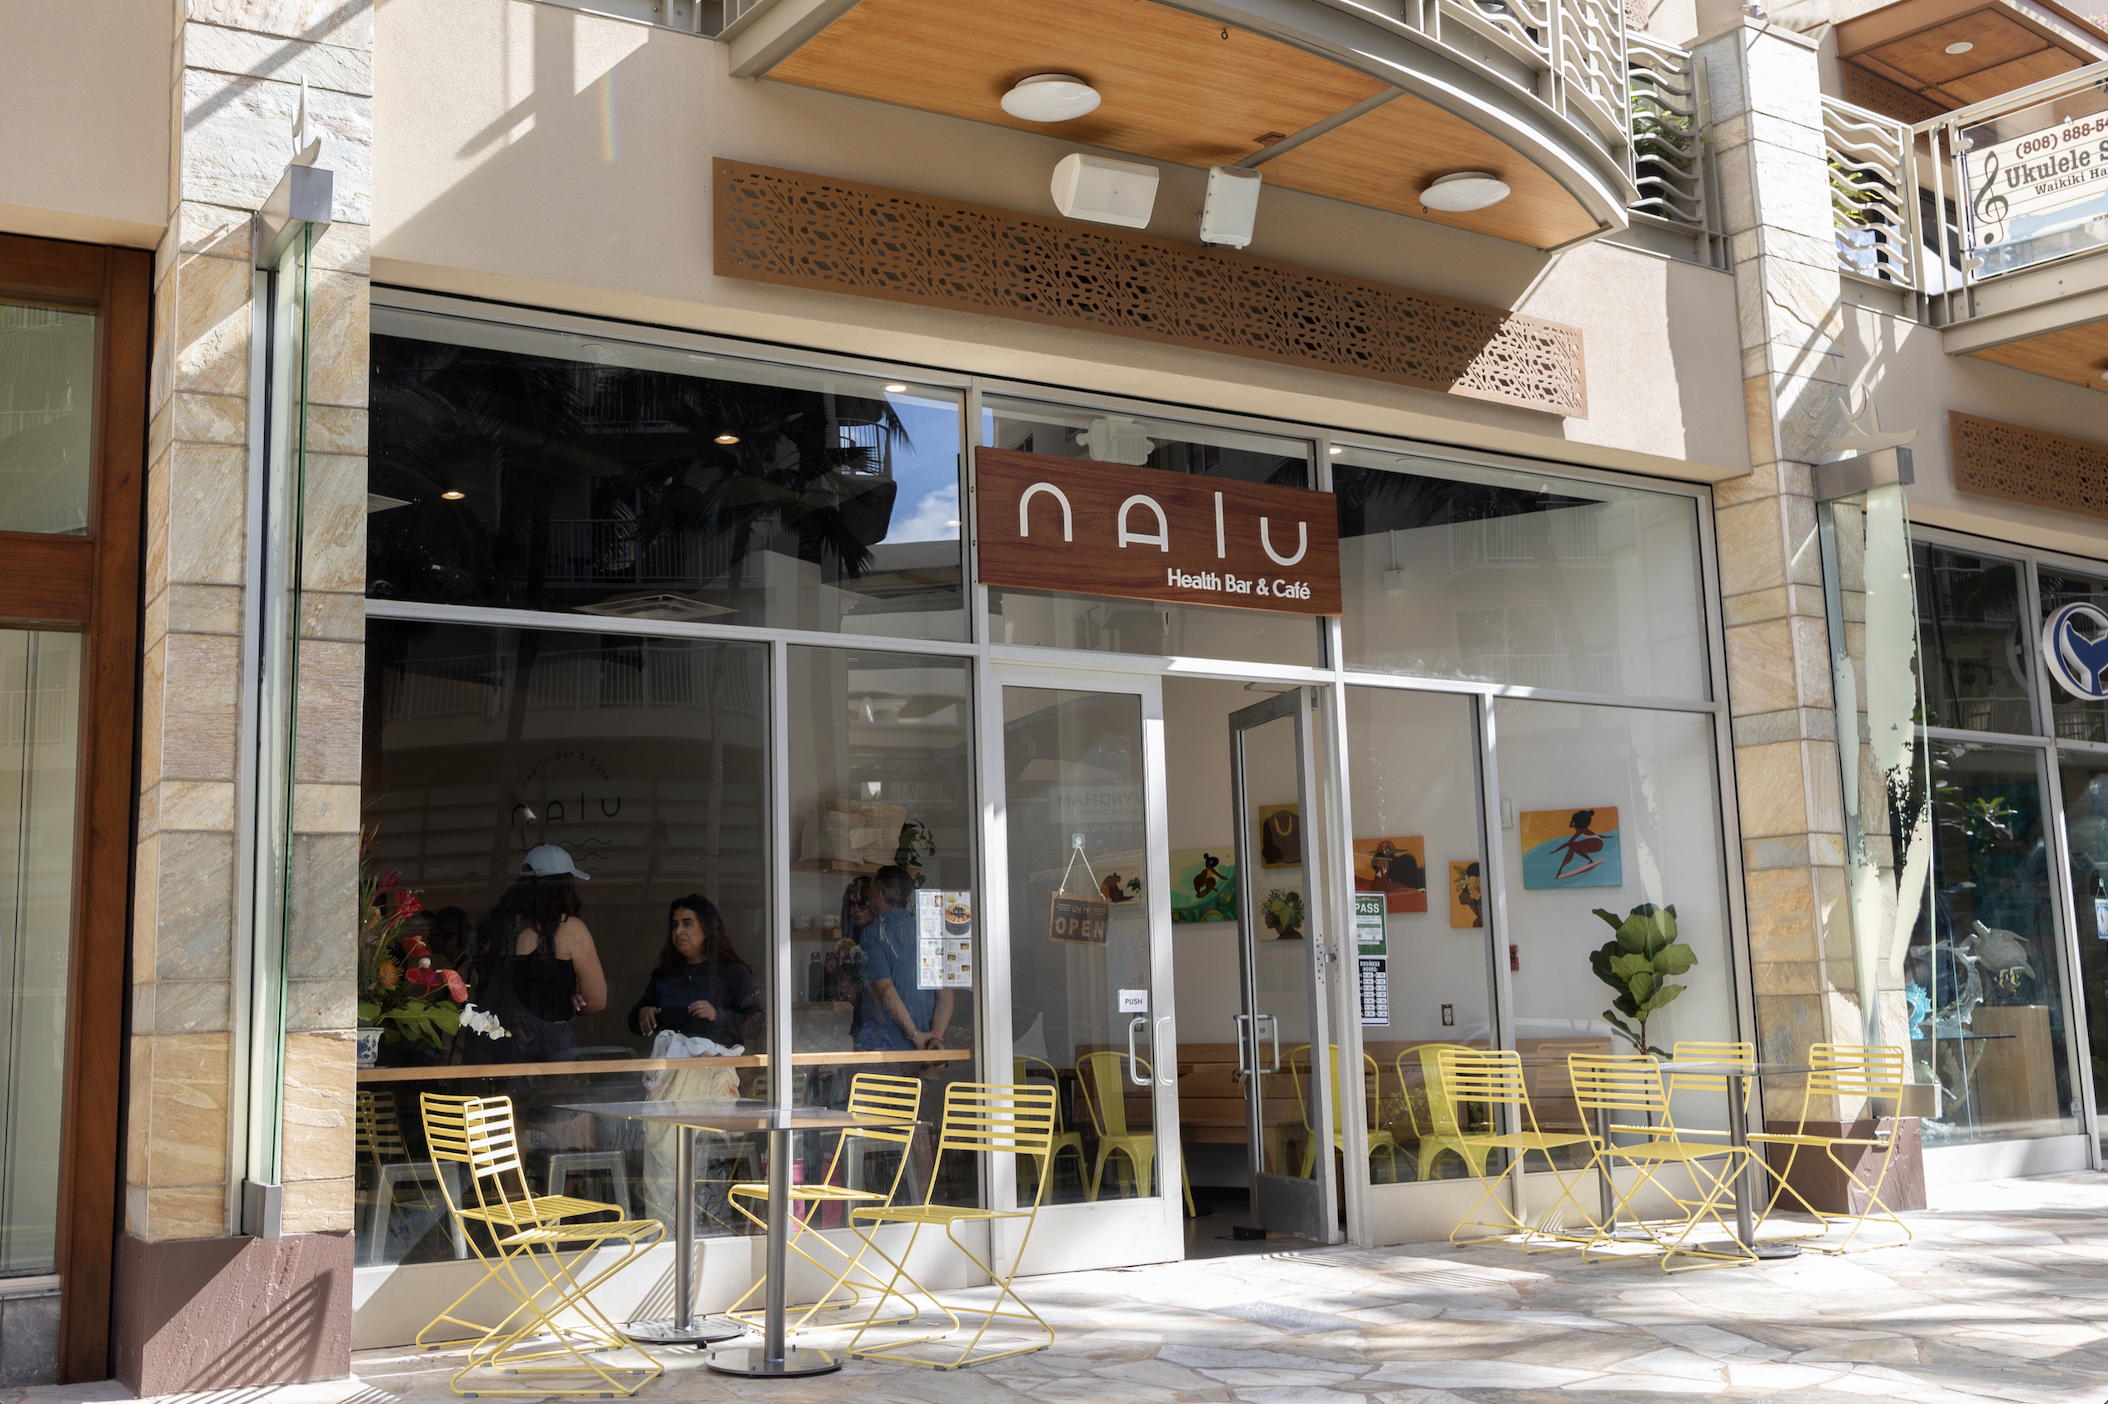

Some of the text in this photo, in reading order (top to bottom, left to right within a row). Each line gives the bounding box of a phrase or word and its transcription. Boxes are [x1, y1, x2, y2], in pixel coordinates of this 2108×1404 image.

[2016, 133, 2058, 159] (808)
[2005, 149, 2090, 189] Ukulele
[2034, 167, 2108, 195] Waikiki Ha
[1167, 567, 1311, 600] Health Bar & Café
[520, 757, 551, 790] Health
[555, 750, 575, 760] Bar
[579, 751, 586, 761] &
[1355, 903, 1380, 913] PASS
[1055, 916, 1105, 939] OPEN
